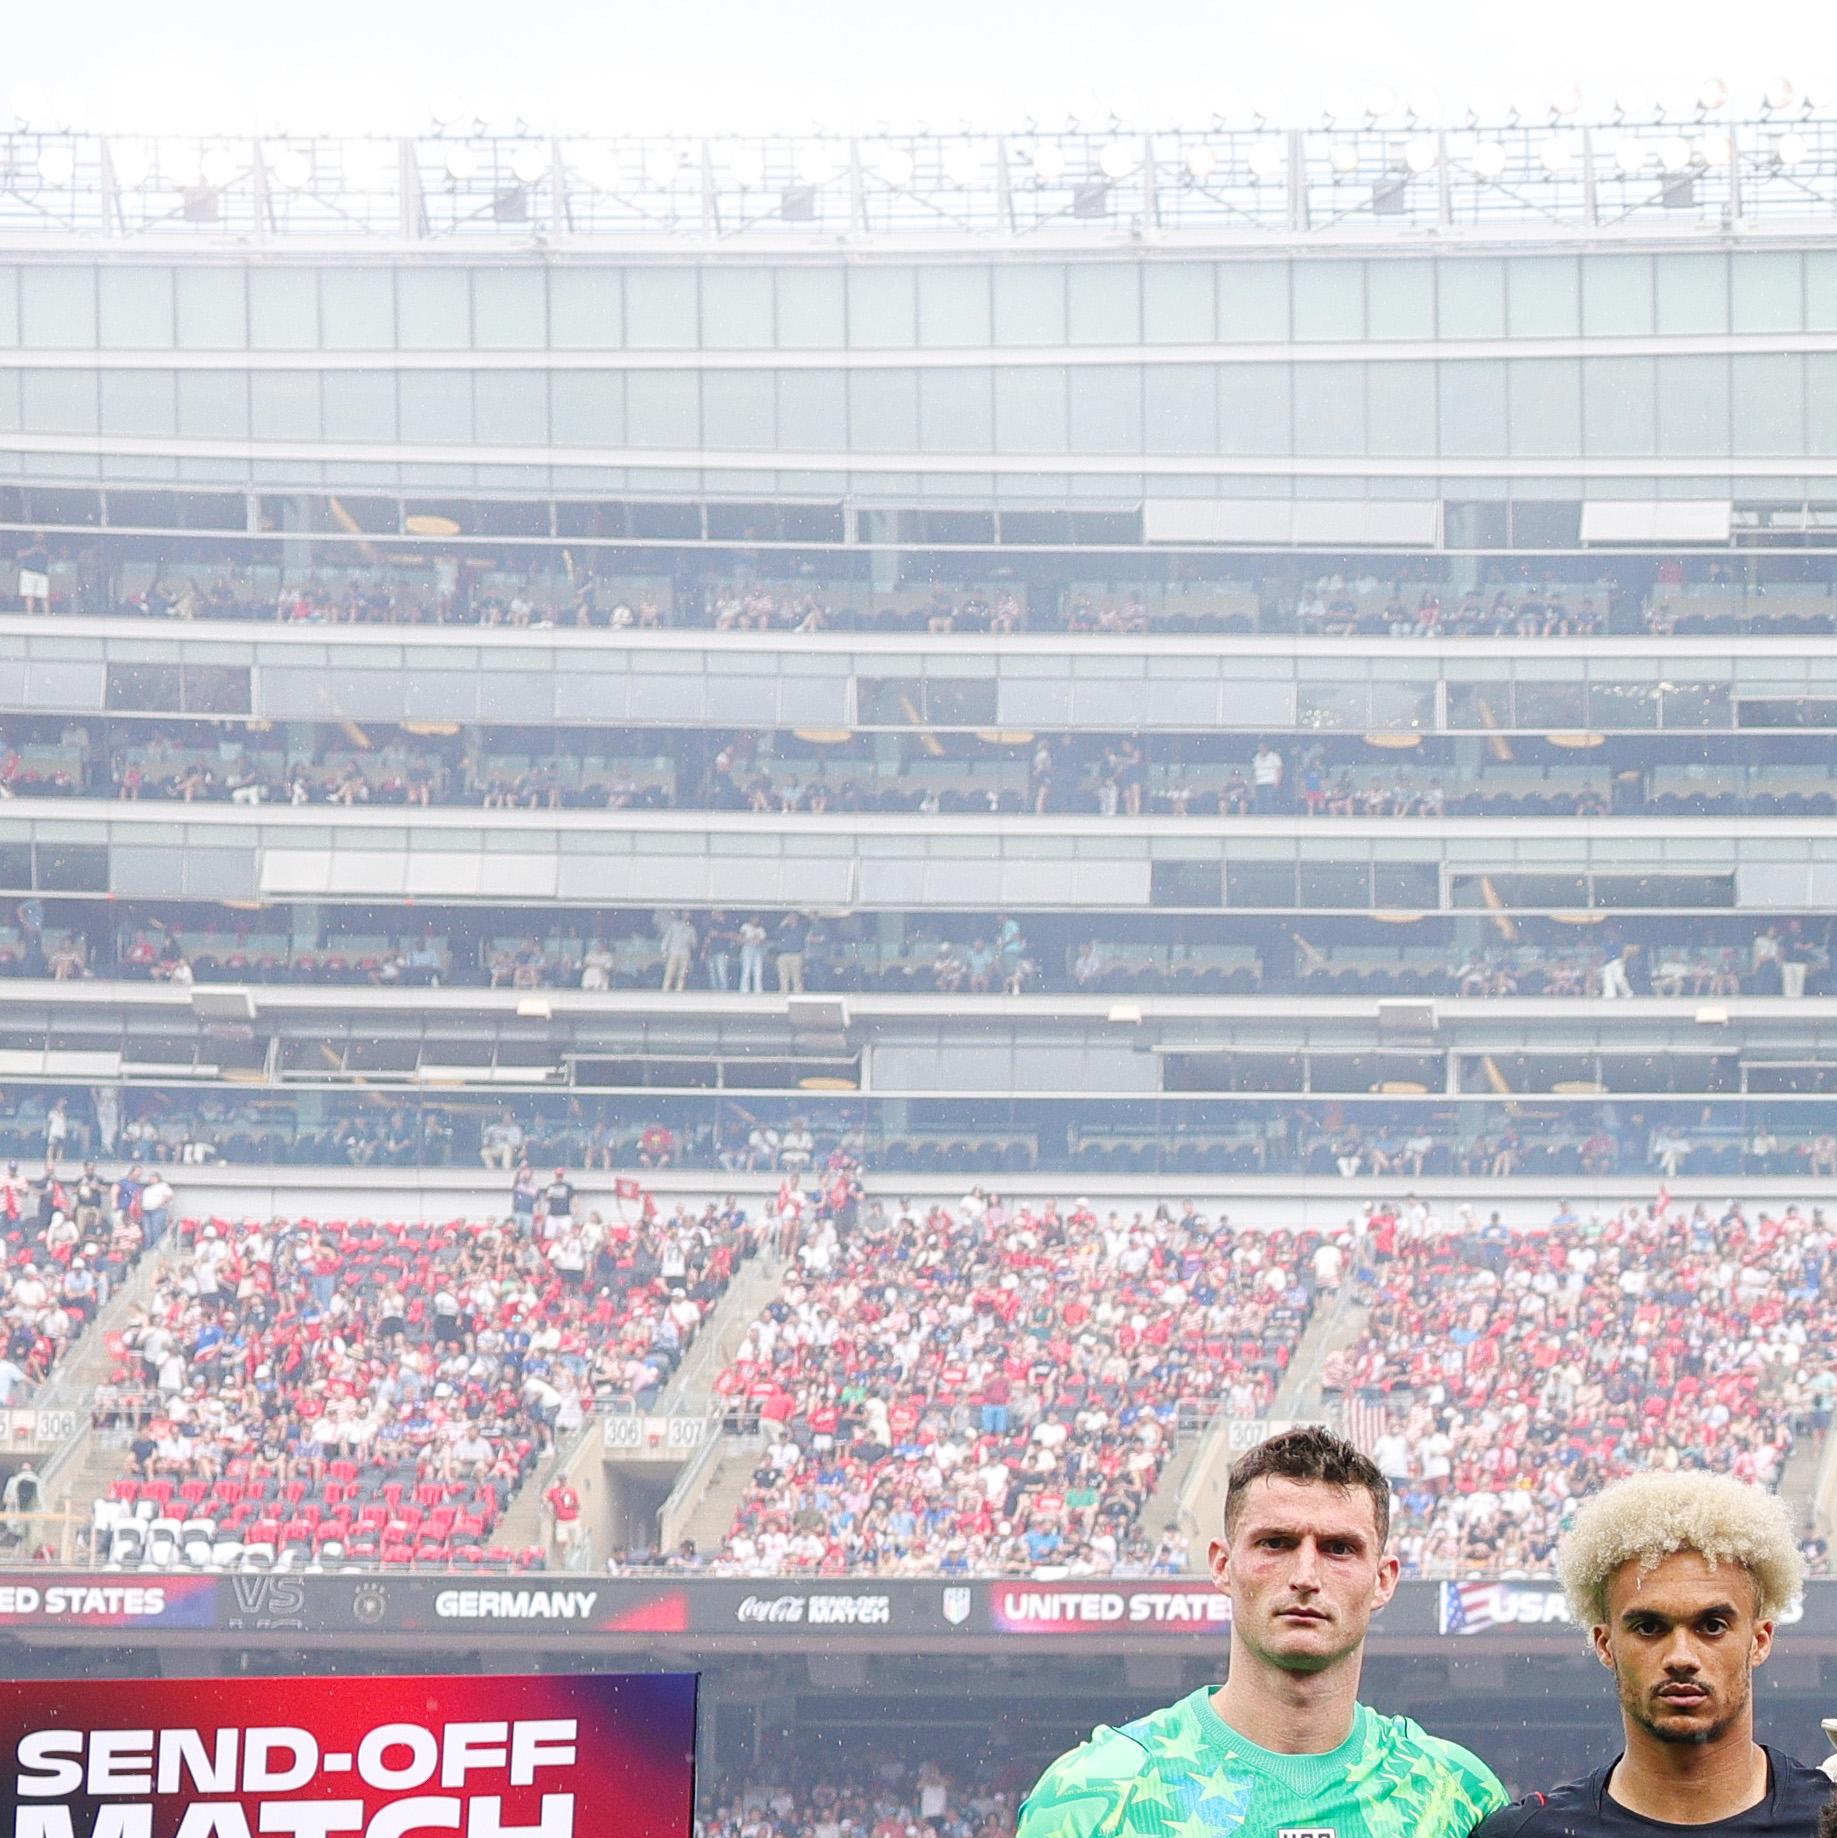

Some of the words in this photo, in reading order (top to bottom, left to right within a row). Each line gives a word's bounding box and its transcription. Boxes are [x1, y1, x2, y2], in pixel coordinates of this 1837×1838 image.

[672, 1421, 702, 1442] 307
[45, 1588, 164, 1614] STATES
[233, 1576, 303, 1614] VS
[435, 1590, 597, 1618] GERMANY
[1005, 1594, 1123, 1621] UNITED
[1494, 1593, 1570, 1623] USA
[808, 1607, 890, 1624] MATCH
[15, 1718, 578, 1796] SEND-OFF
